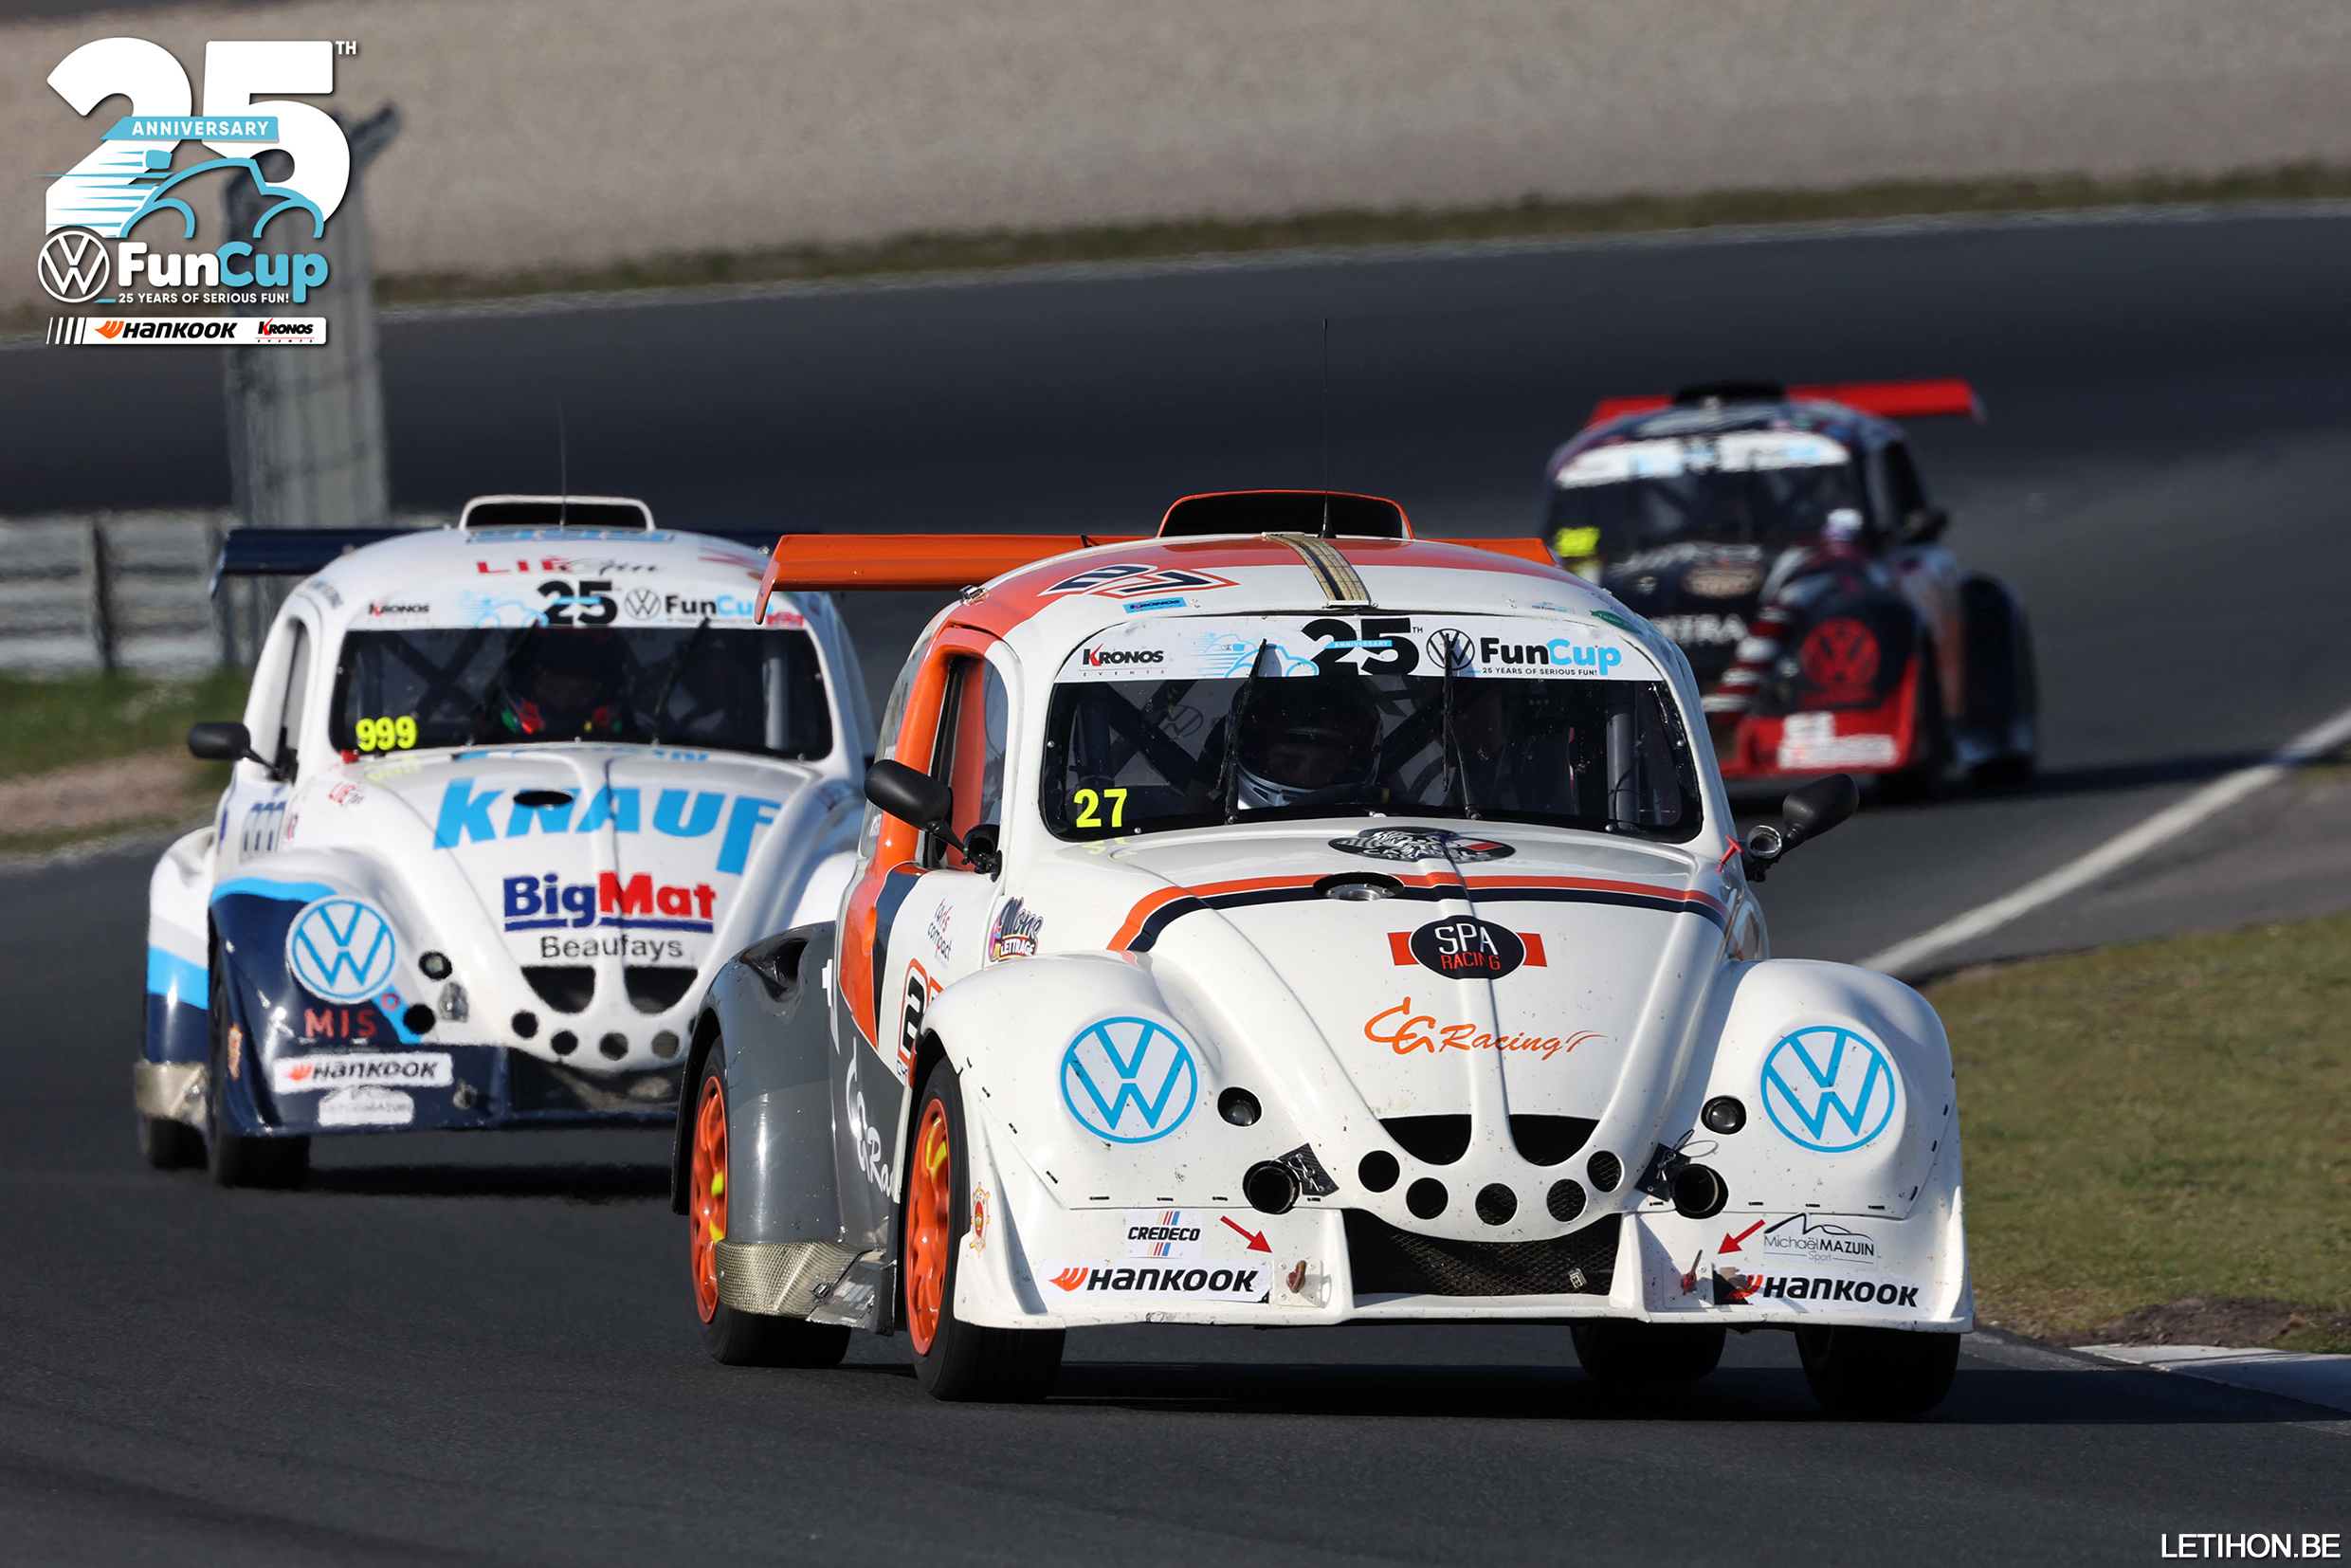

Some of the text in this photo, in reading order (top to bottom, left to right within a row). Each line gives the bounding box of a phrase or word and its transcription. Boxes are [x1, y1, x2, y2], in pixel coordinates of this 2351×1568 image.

[1045, 565, 1223, 595] 27
[538, 580, 618, 626] 25
[1083, 644, 1164, 666] KRONOS
[1302, 617, 1420, 676] 25
[1334, 640, 1389, 648] ANNIVERSARY
[1481, 637, 1622, 676] FunCup
[1495, 666, 1522, 675] YEARS
[1540, 667, 1576, 676] SERIOUS
[355, 716, 417, 751] 999
[1074, 788, 1128, 828] 27
[433, 776, 782, 876] KNAUF
[502, 871, 717, 929] BigMat
[540, 935, 683, 959] Beaufays
[1000, 938, 1035, 957] LETTRAGE
[1434, 922, 1499, 956] SPA
[1440, 952, 1501, 971] RACING
[303, 1008, 377, 1038] MIS
[1439, 1023, 1563, 1061] Racing
[1127, 1226, 1201, 1241] CREDECO
[1808, 1251, 1832, 1263] Sport
